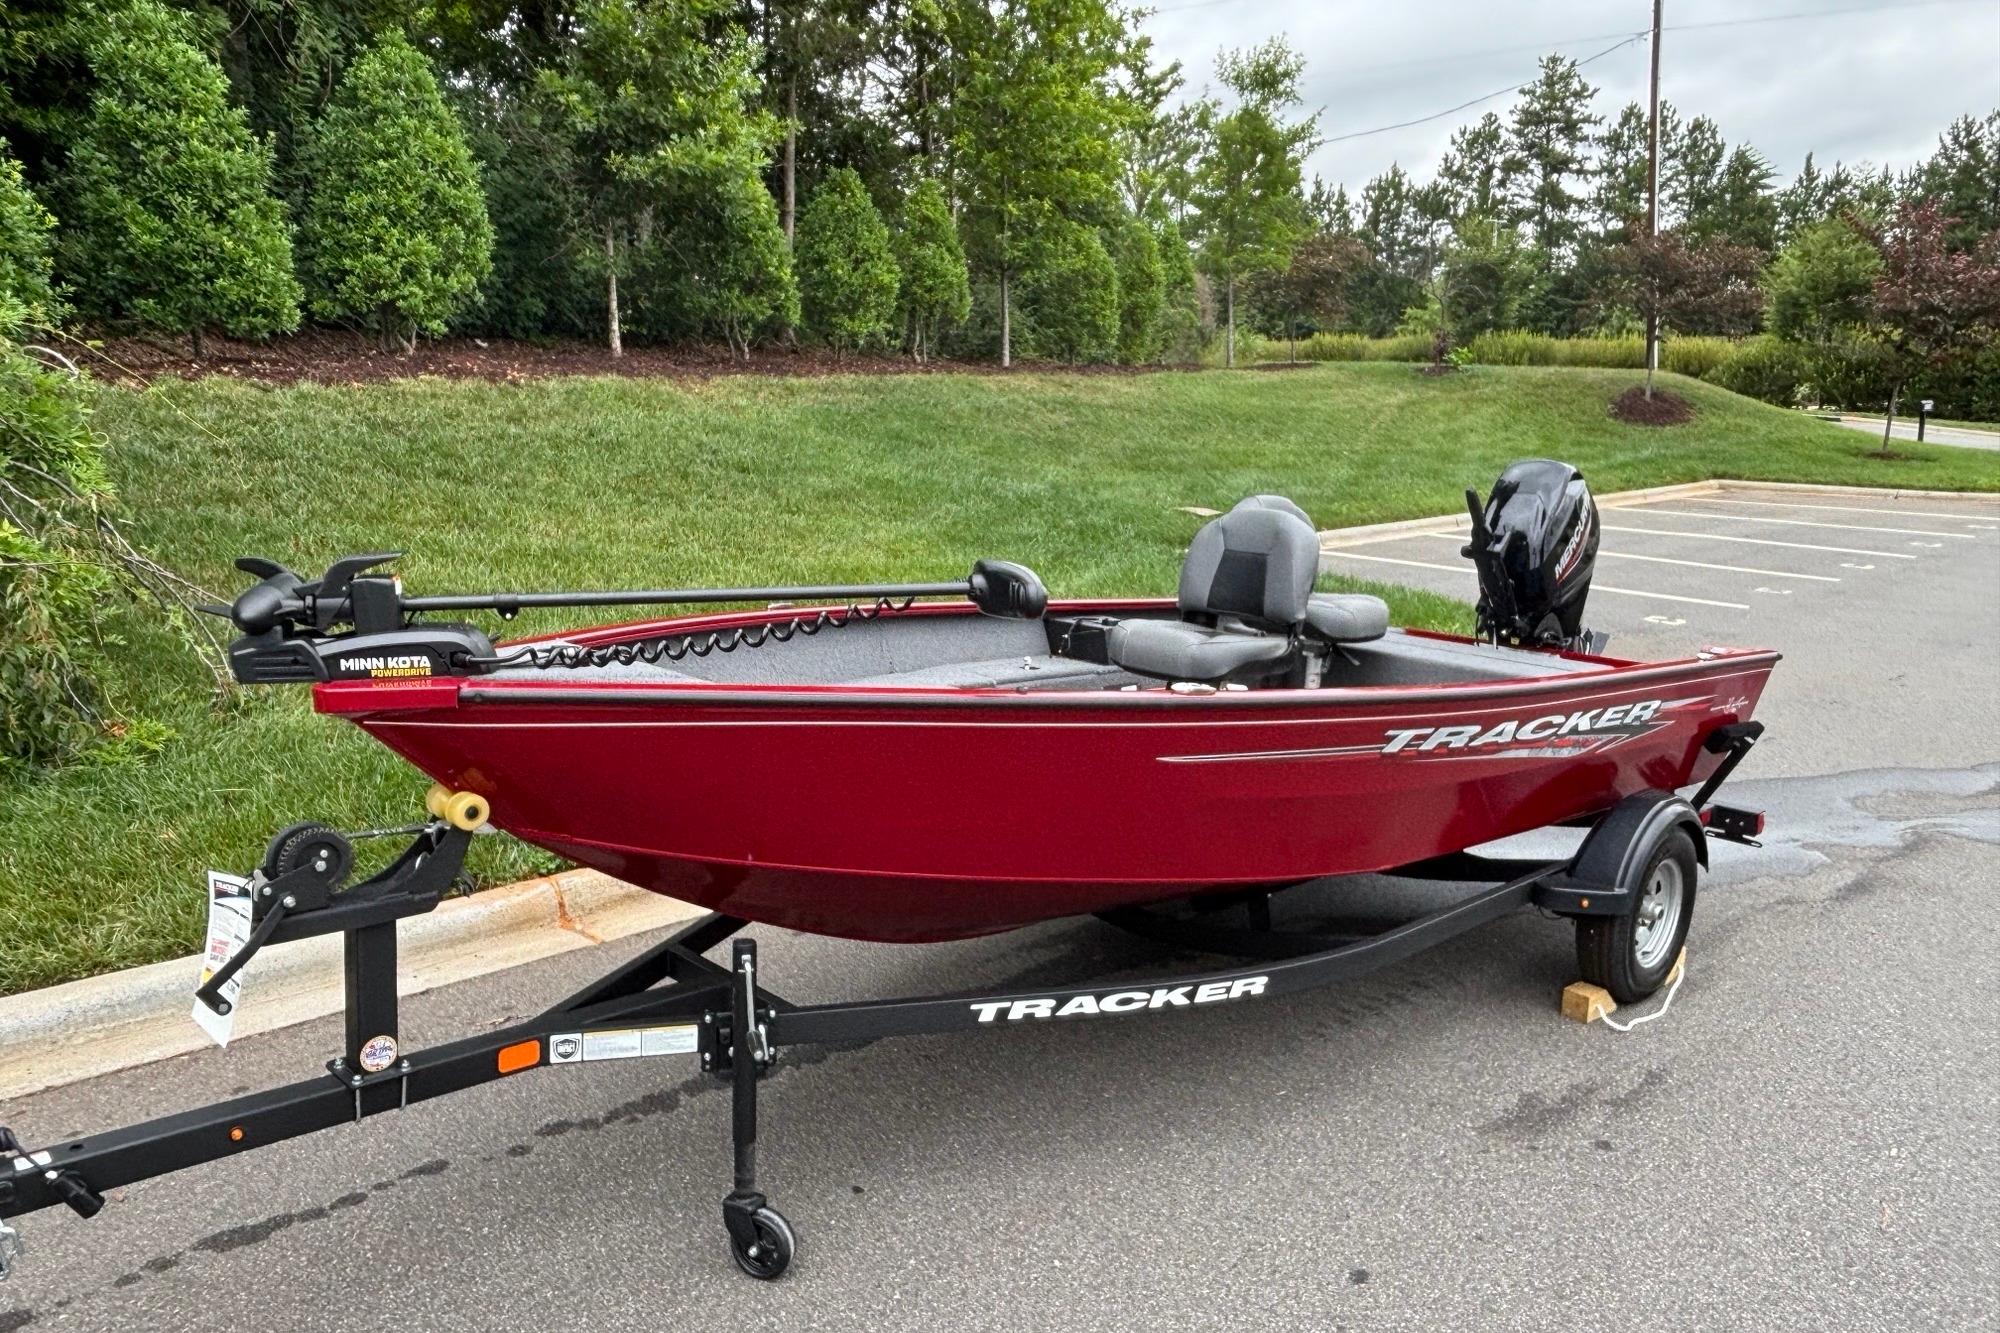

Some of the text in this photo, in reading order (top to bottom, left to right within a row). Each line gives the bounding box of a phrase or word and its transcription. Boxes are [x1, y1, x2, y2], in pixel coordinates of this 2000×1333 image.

[340, 656, 431, 671] MINN KOTA
[371, 668, 431, 677] POWERDRIVE
[1381, 699, 1662, 753] TRACKER
[970, 976, 1269, 1022] TRACKER
